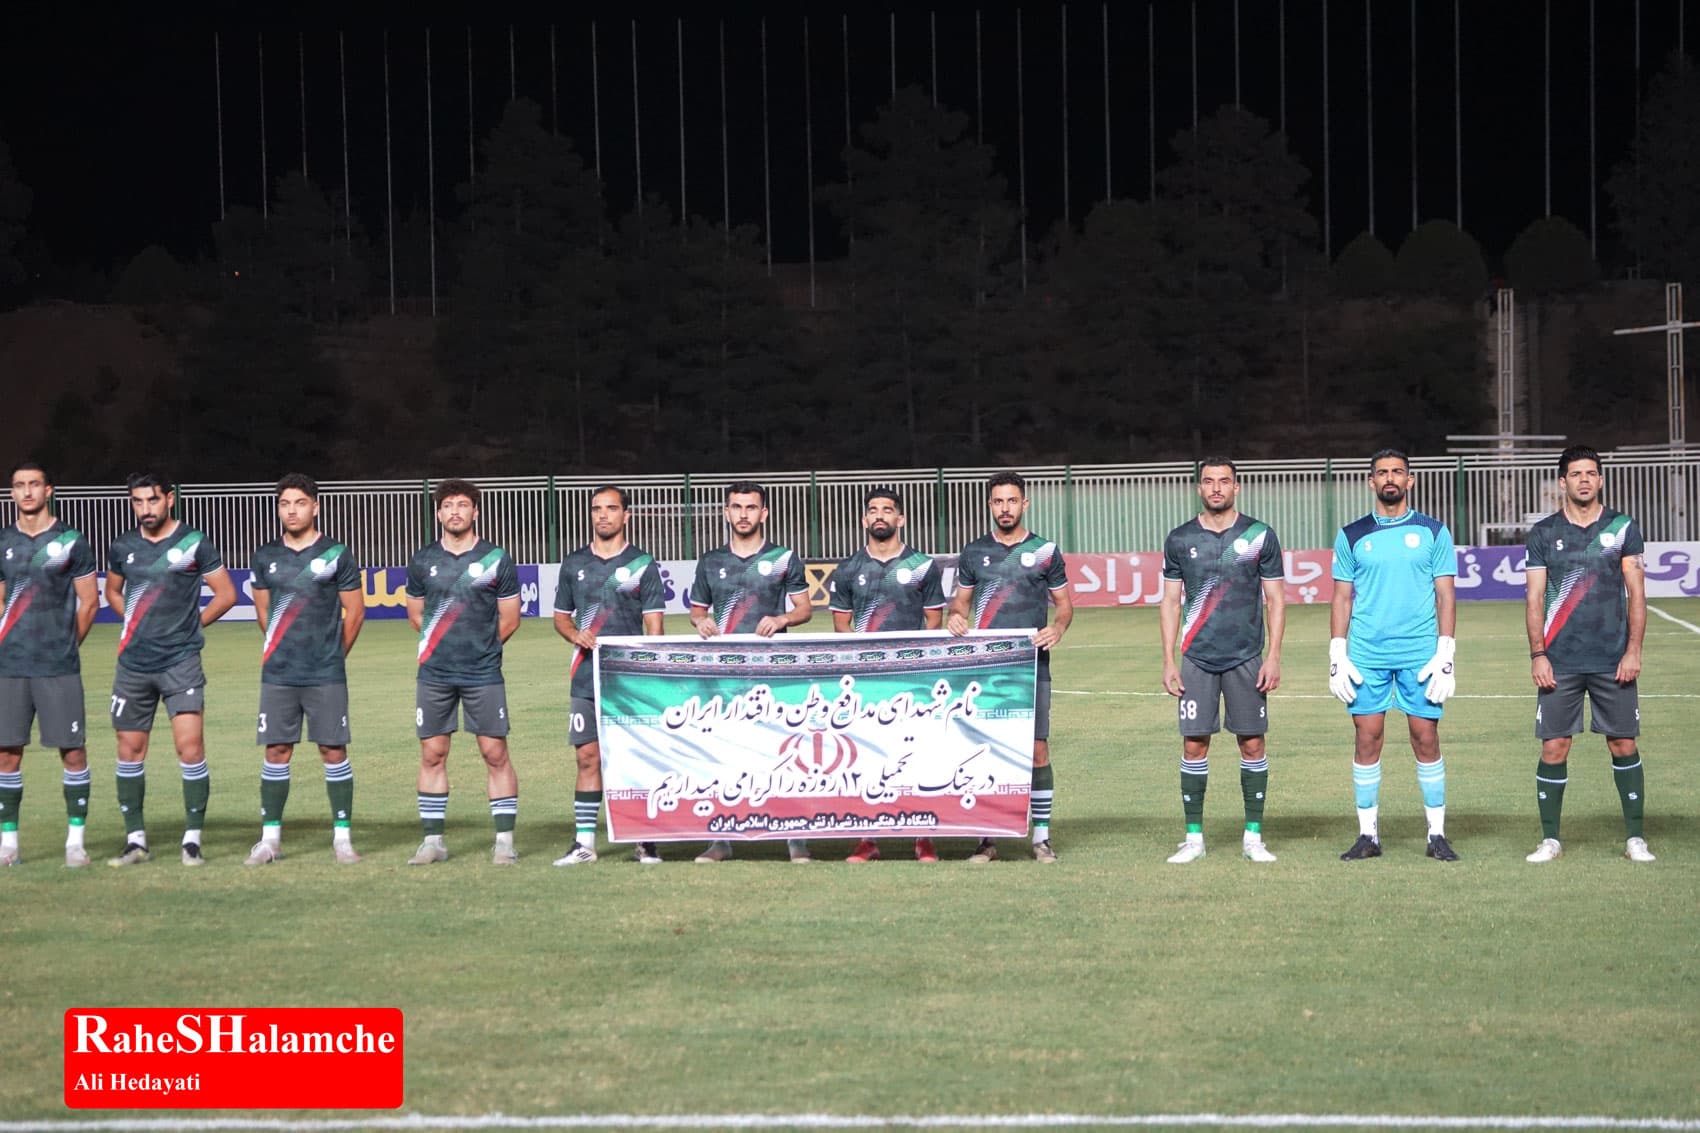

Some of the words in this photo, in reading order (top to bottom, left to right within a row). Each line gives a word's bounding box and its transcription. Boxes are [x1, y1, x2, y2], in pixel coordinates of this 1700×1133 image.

[666, 701, 718, 733] ایران
[724, 690, 770, 721] اقتدار
[786, 688, 829, 727] وطن
[831, 680, 875, 729] مدافع
[878, 684, 948, 725] شهدای
[945, 686, 977, 732] نام
[1180, 699, 1198, 721] 58
